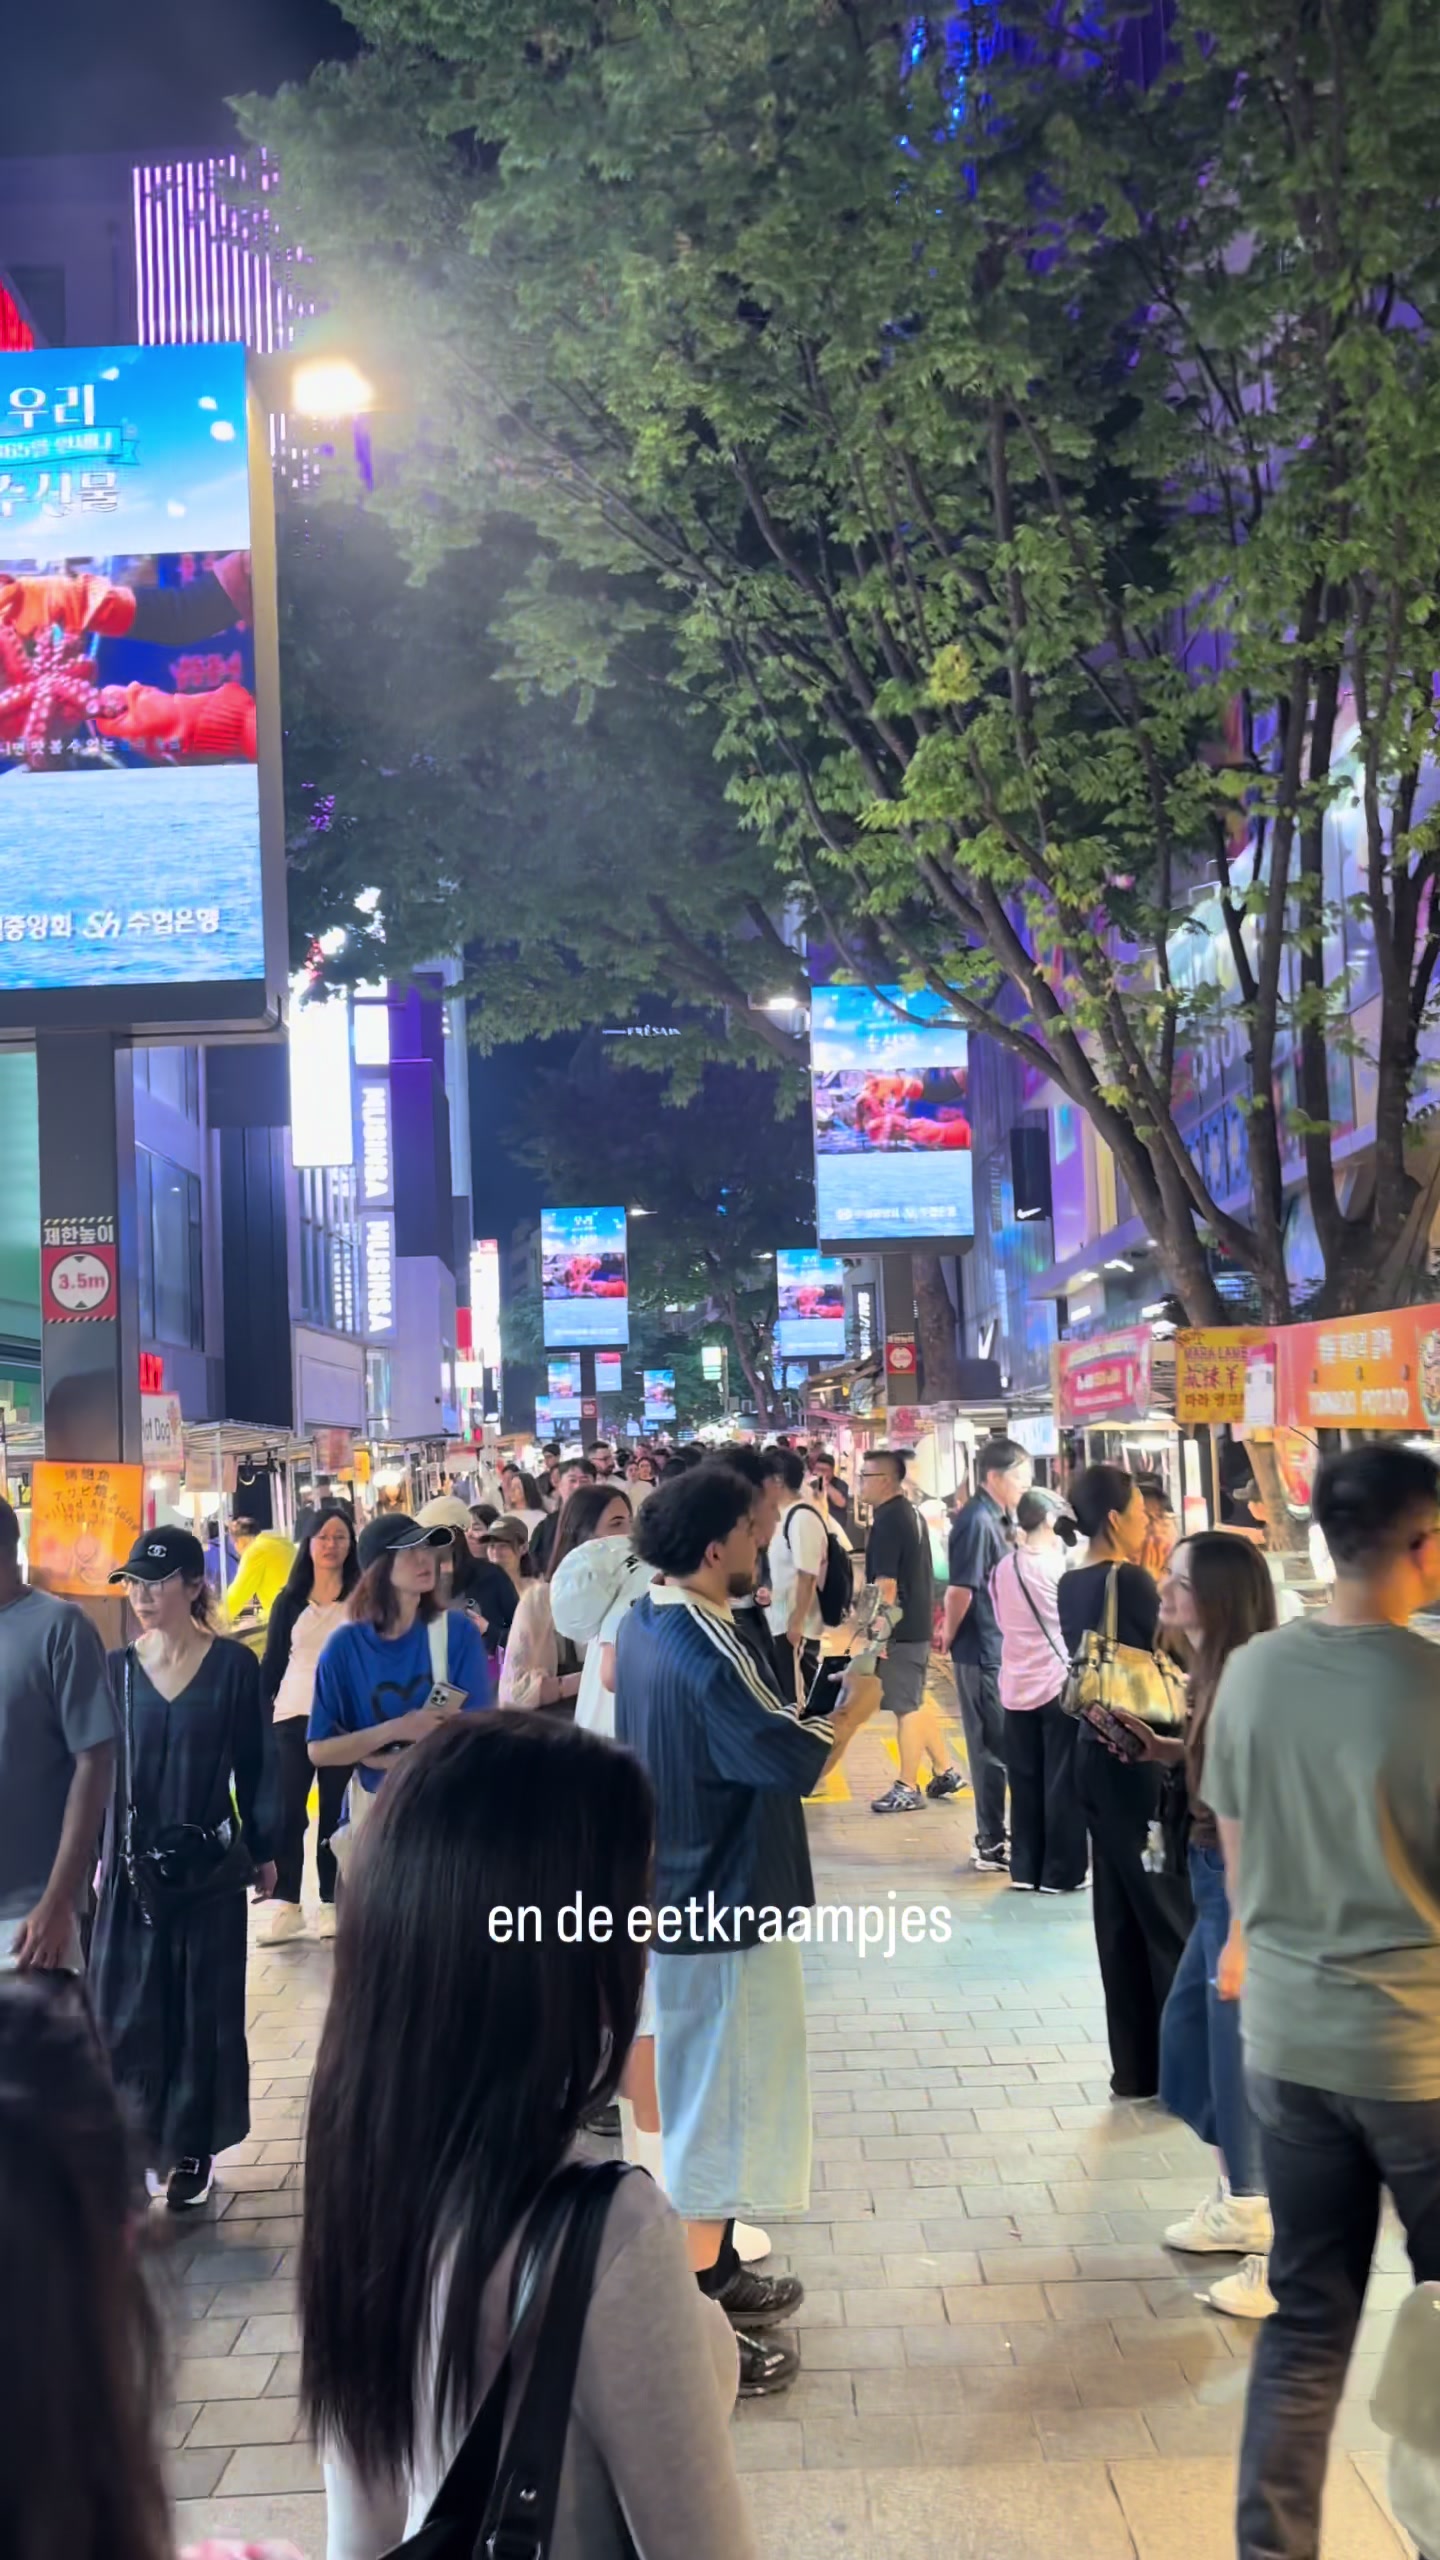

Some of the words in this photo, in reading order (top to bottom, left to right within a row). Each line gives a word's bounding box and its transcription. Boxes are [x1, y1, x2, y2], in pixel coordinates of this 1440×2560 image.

[7, 384, 95, 429] 우리
[0, 911, 72, 942] 중앙회
[83, 909, 121, 939] Sh
[361, 1086, 389, 1199] MUSINSA
[43, 1225, 114, 1246] 제한높이
[58, 1272, 106, 1290] 3.5m
[366, 1220, 393, 1333] MUSINSA
